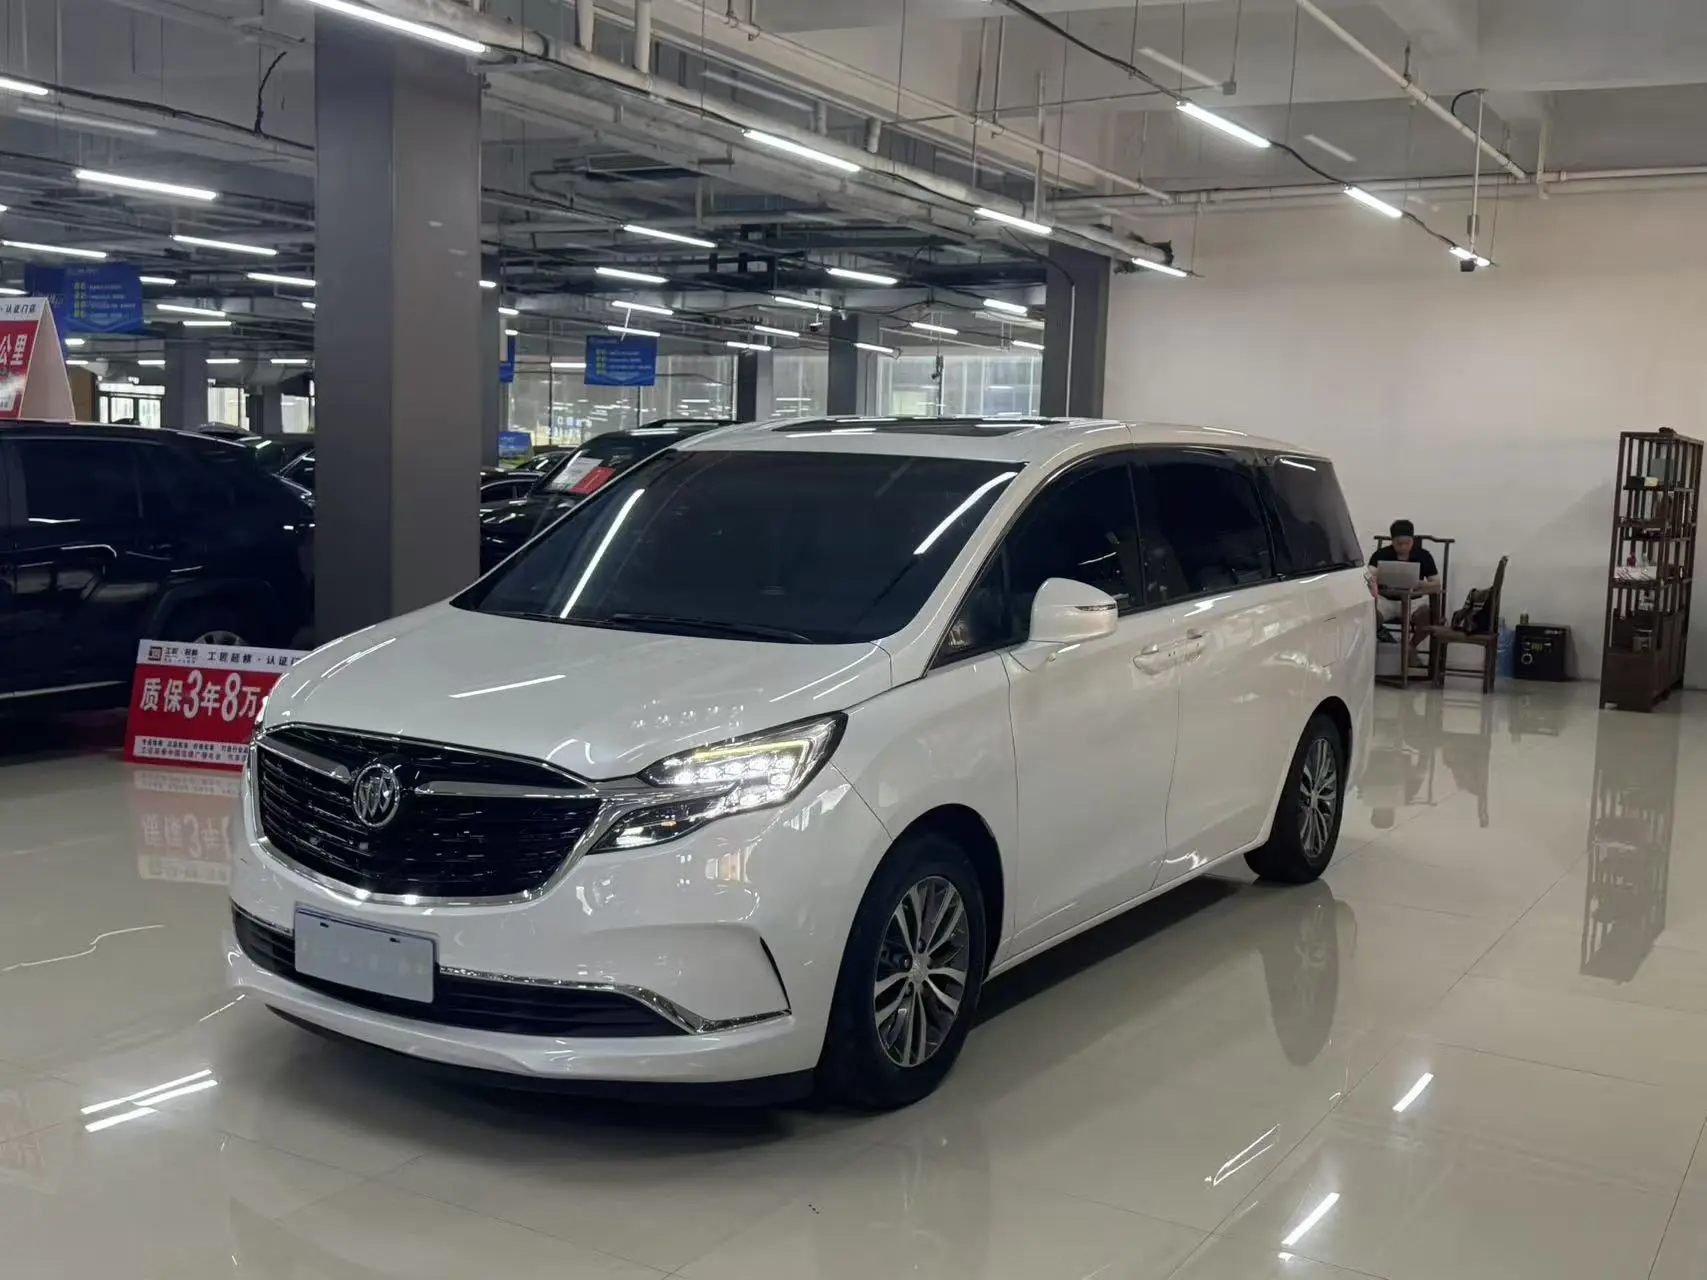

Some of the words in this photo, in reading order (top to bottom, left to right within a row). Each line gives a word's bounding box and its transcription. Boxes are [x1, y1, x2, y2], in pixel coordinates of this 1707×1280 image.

[0, 333, 28, 366] 公里
[139, 669, 261, 722] 质保3年8万
